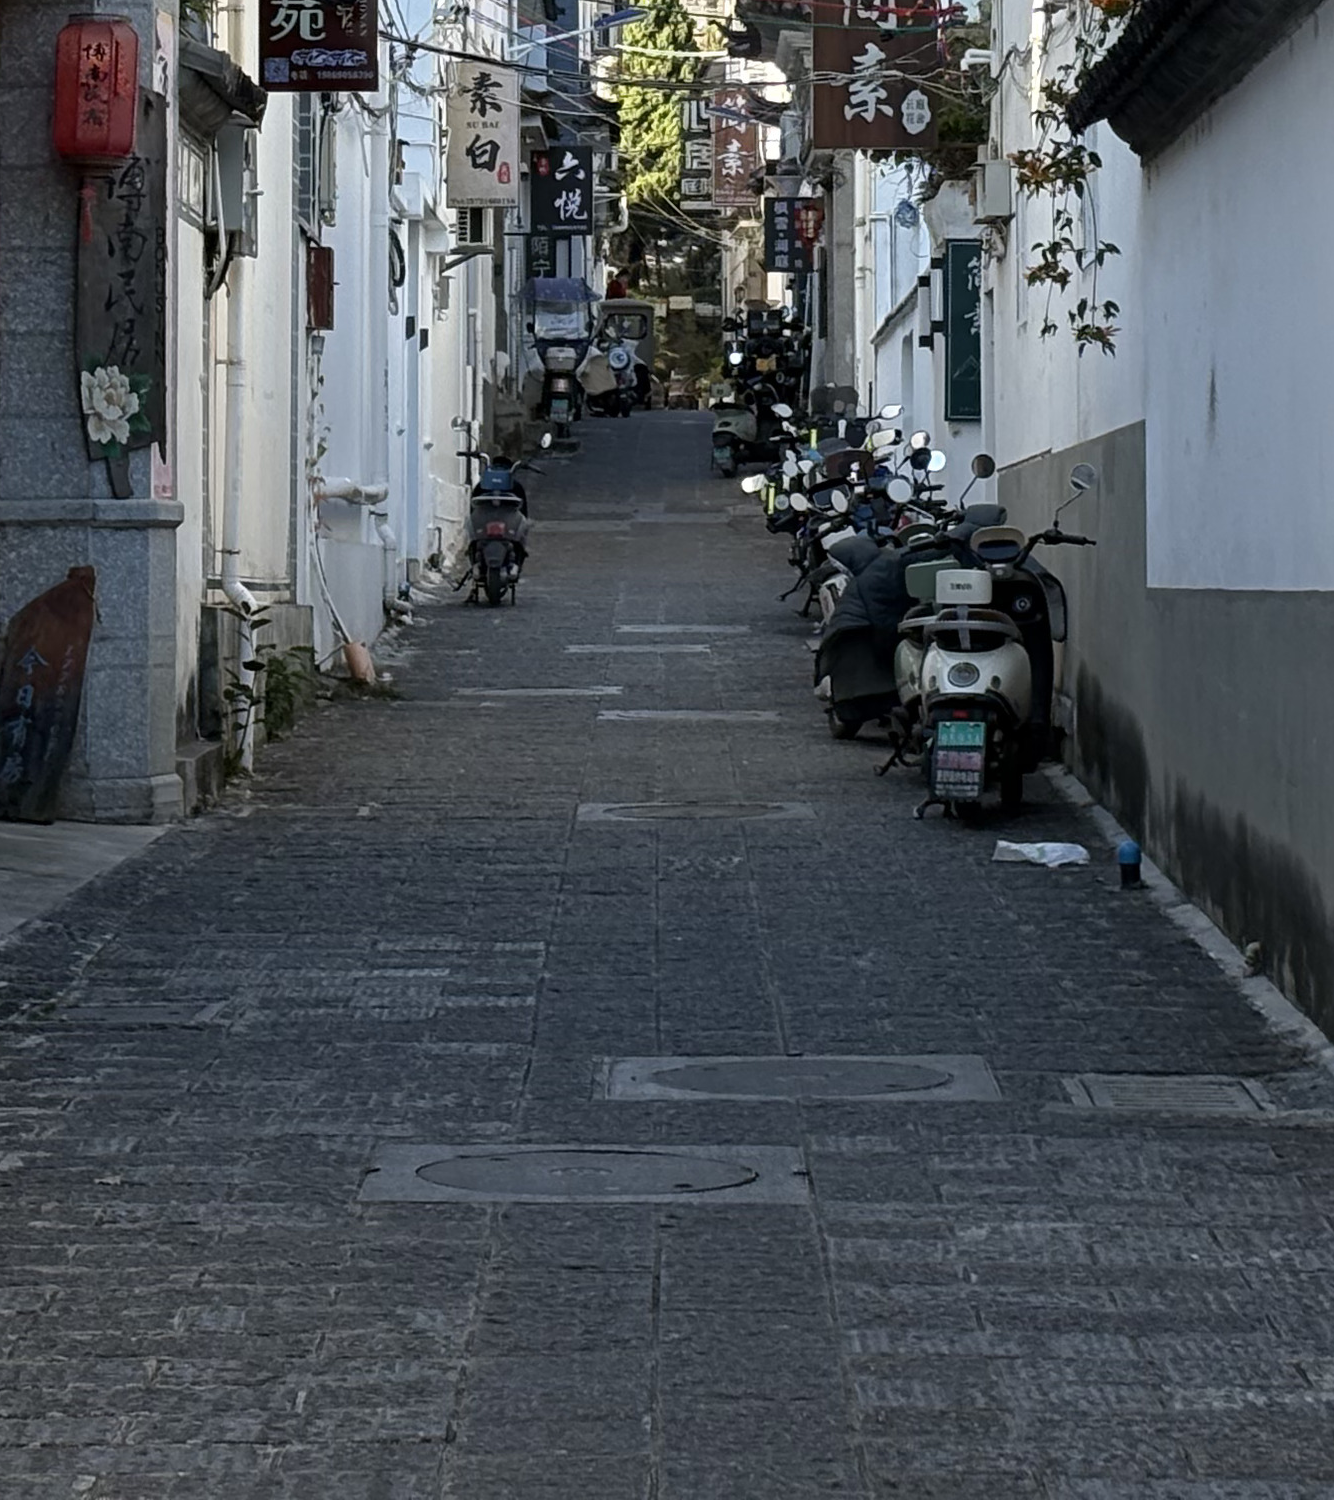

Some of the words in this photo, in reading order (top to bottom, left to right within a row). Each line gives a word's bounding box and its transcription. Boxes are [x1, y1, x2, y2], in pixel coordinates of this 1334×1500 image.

[463, 72, 503, 172] 素白
[554, 151, 588, 221] 六悦
[104, 153, 150, 367] 博南民居
